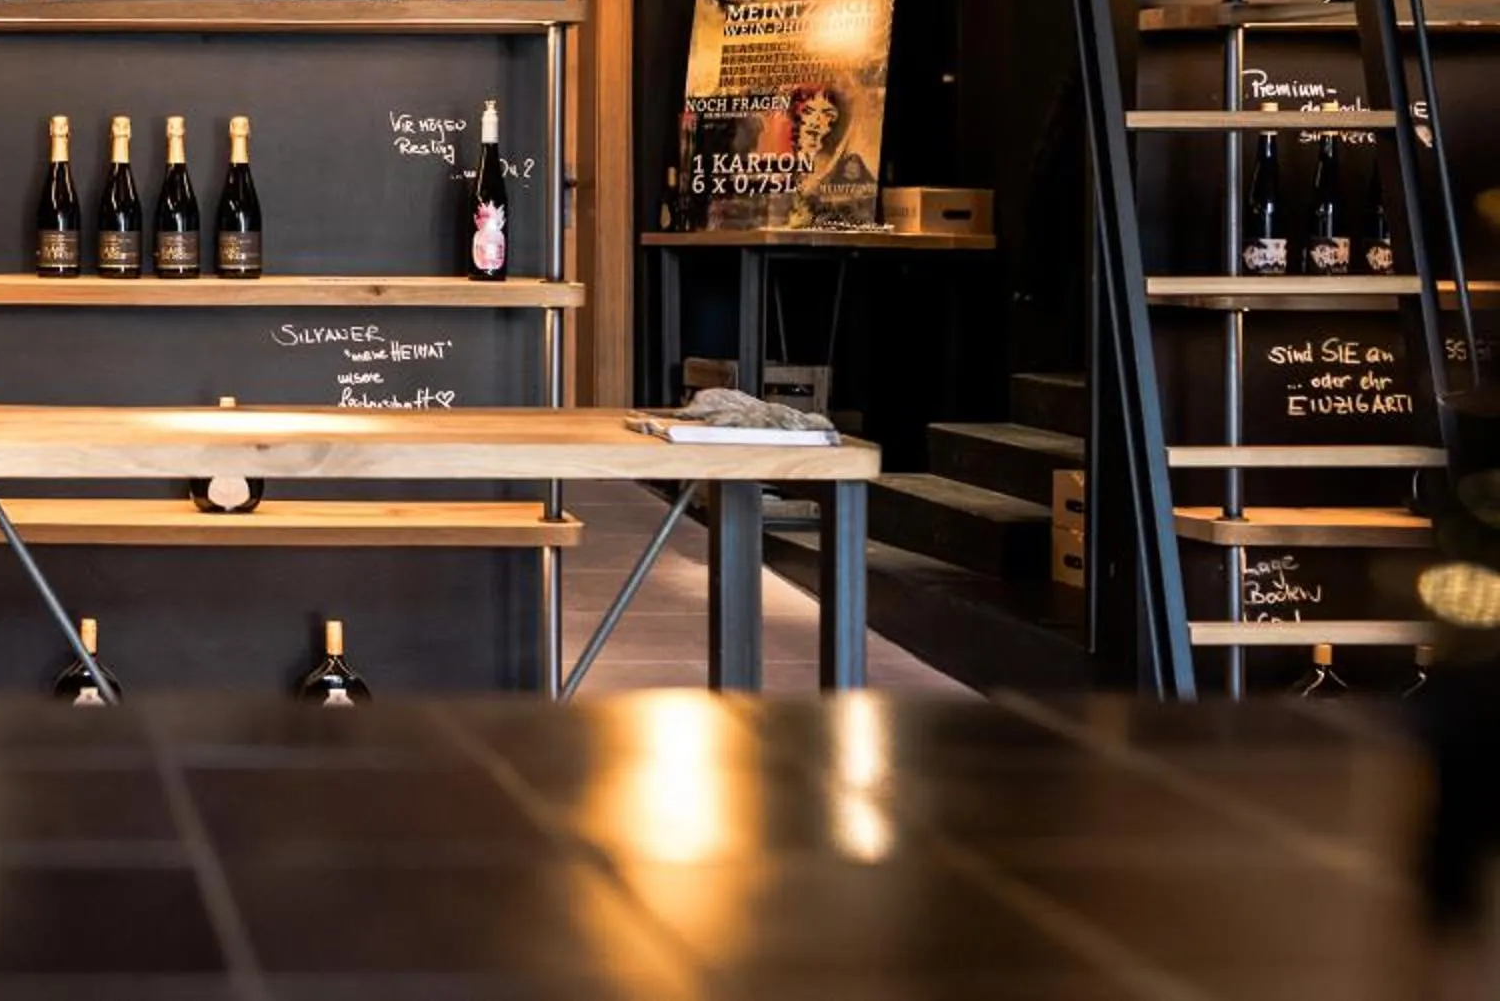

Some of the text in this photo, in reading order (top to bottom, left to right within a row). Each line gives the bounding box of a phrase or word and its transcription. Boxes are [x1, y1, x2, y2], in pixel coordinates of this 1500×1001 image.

[685, 96, 792, 112] NOCH FRAGEN
[693, 152, 815, 174] 1 KARTON
[692, 174, 706, 194] 6
[733, 173, 798, 197] 0,75L
[1320, 337, 1361, 364] SIE
